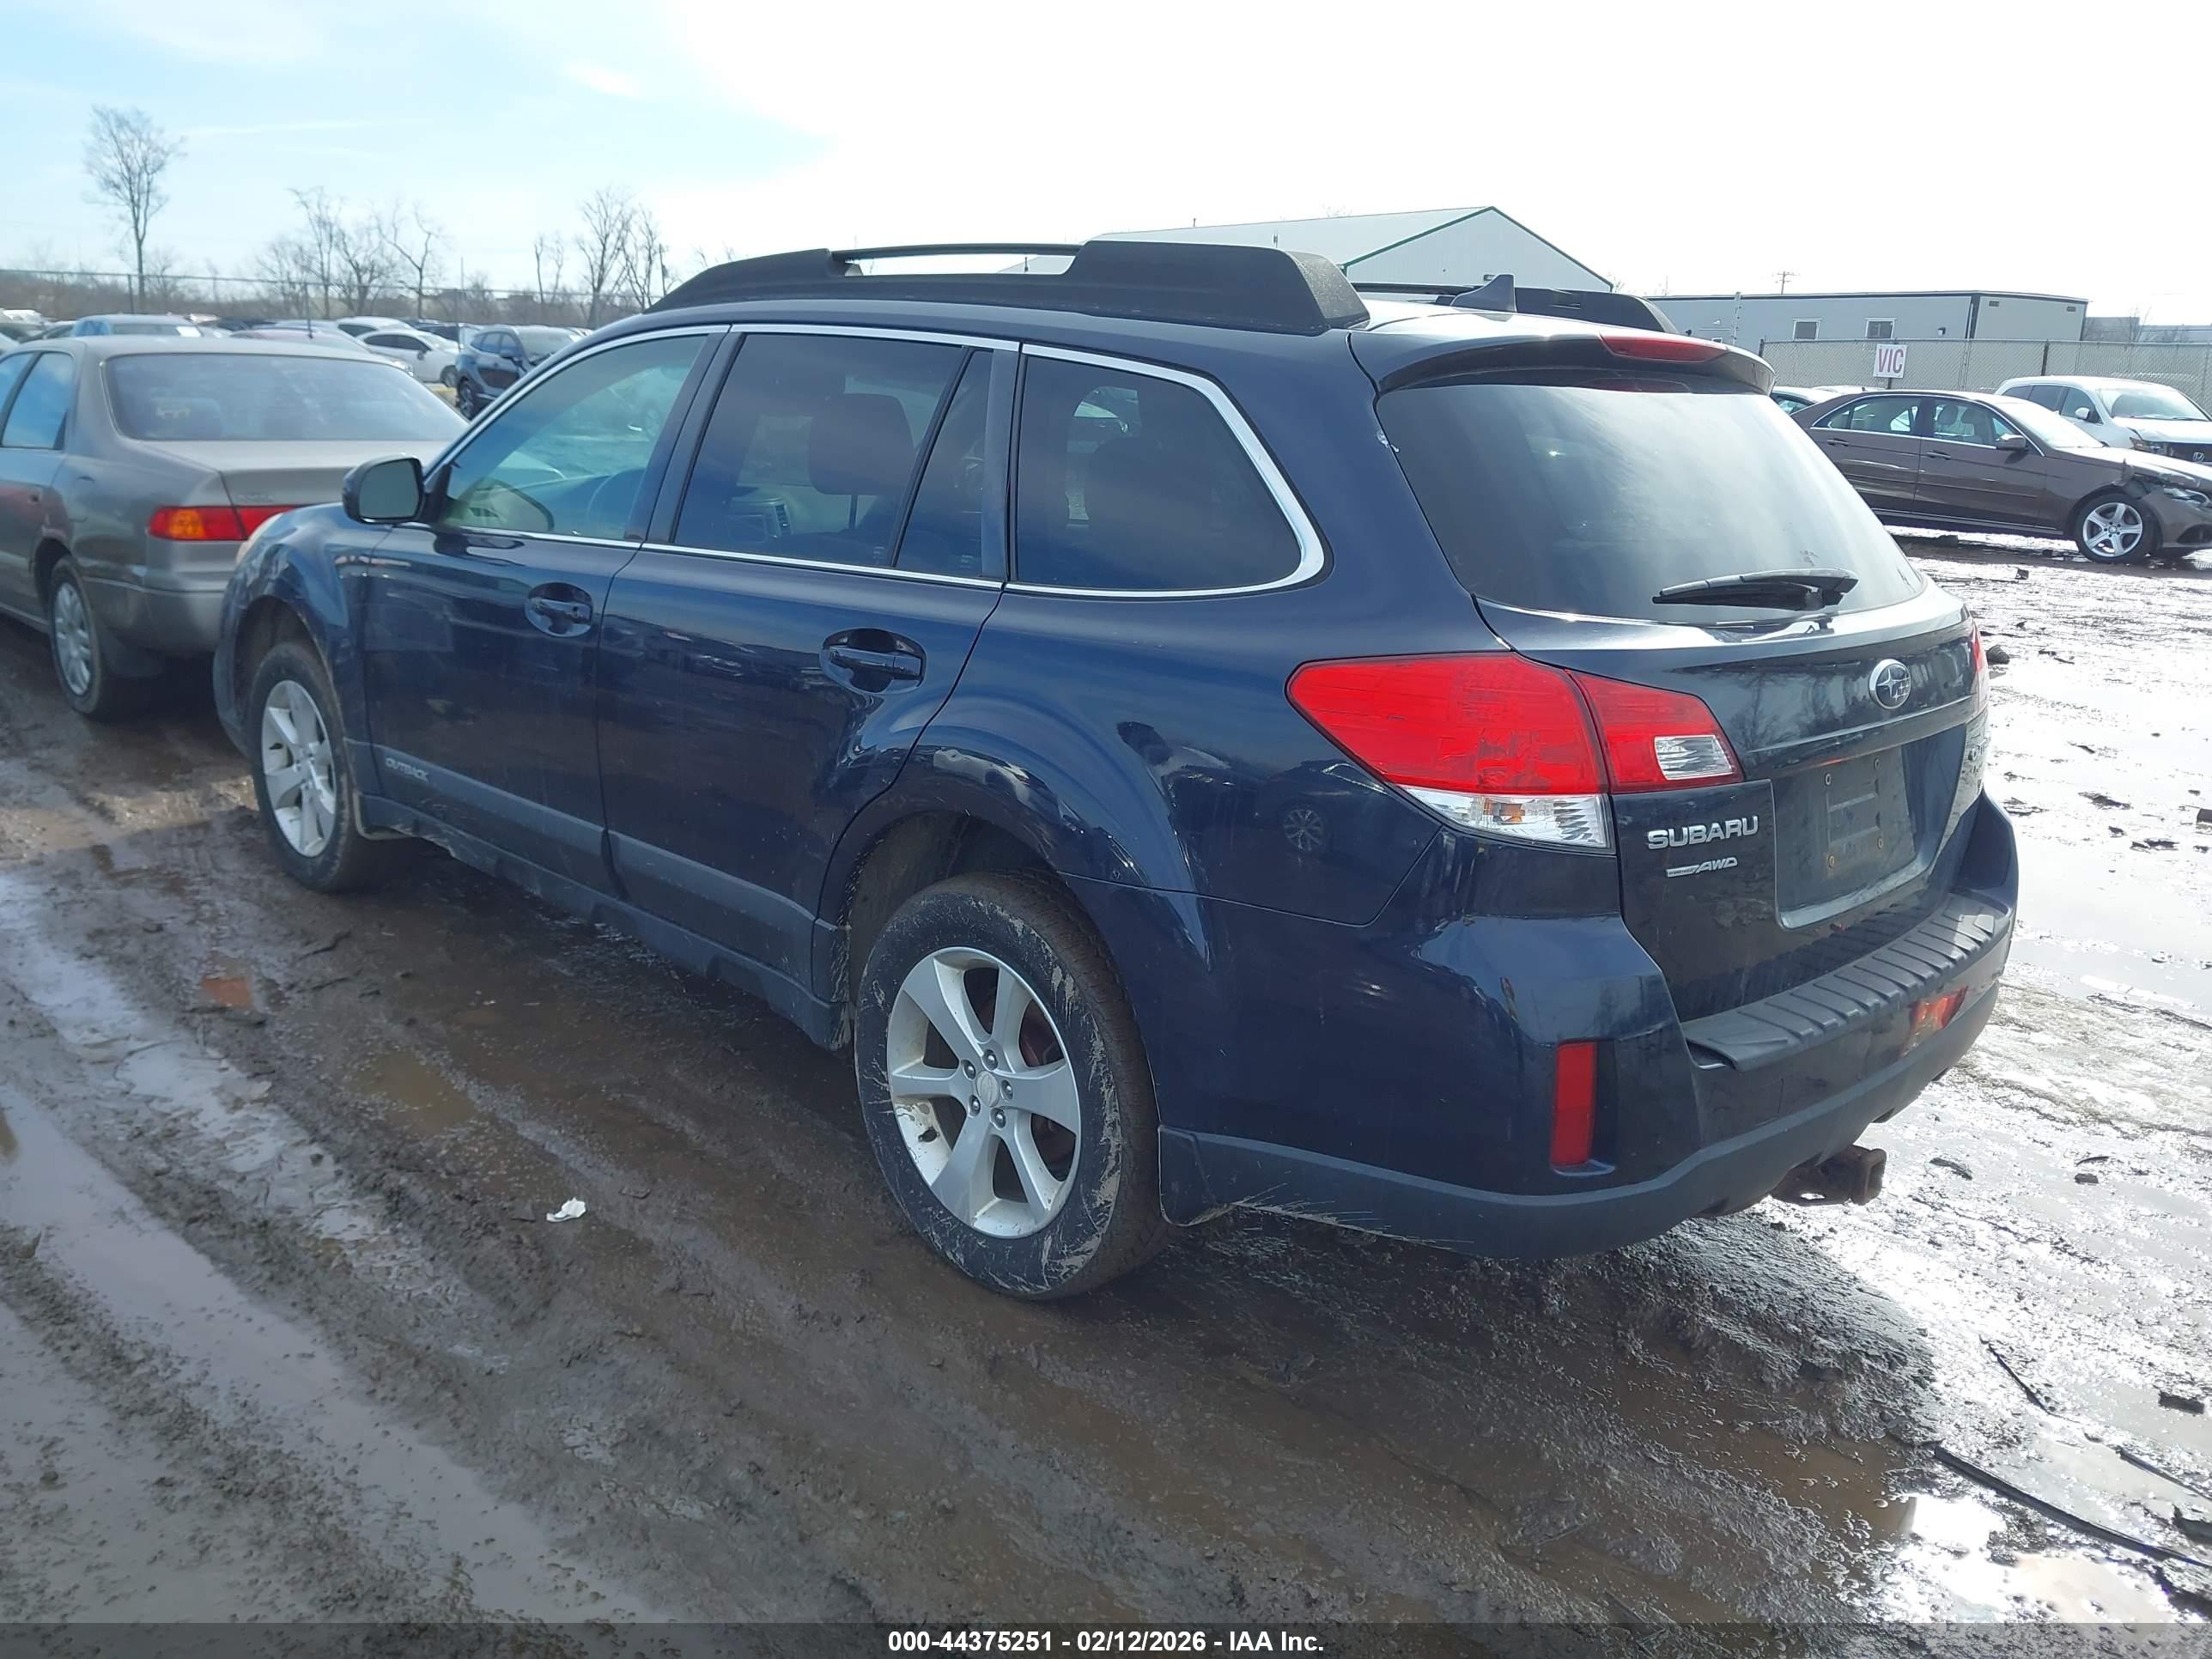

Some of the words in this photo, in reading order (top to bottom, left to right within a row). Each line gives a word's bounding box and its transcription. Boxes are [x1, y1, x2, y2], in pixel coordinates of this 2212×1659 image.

[1879, 348, 1904, 374] VIC
[1648, 816, 1759, 849] SUBARU
[1695, 857, 1738, 873] AWD
